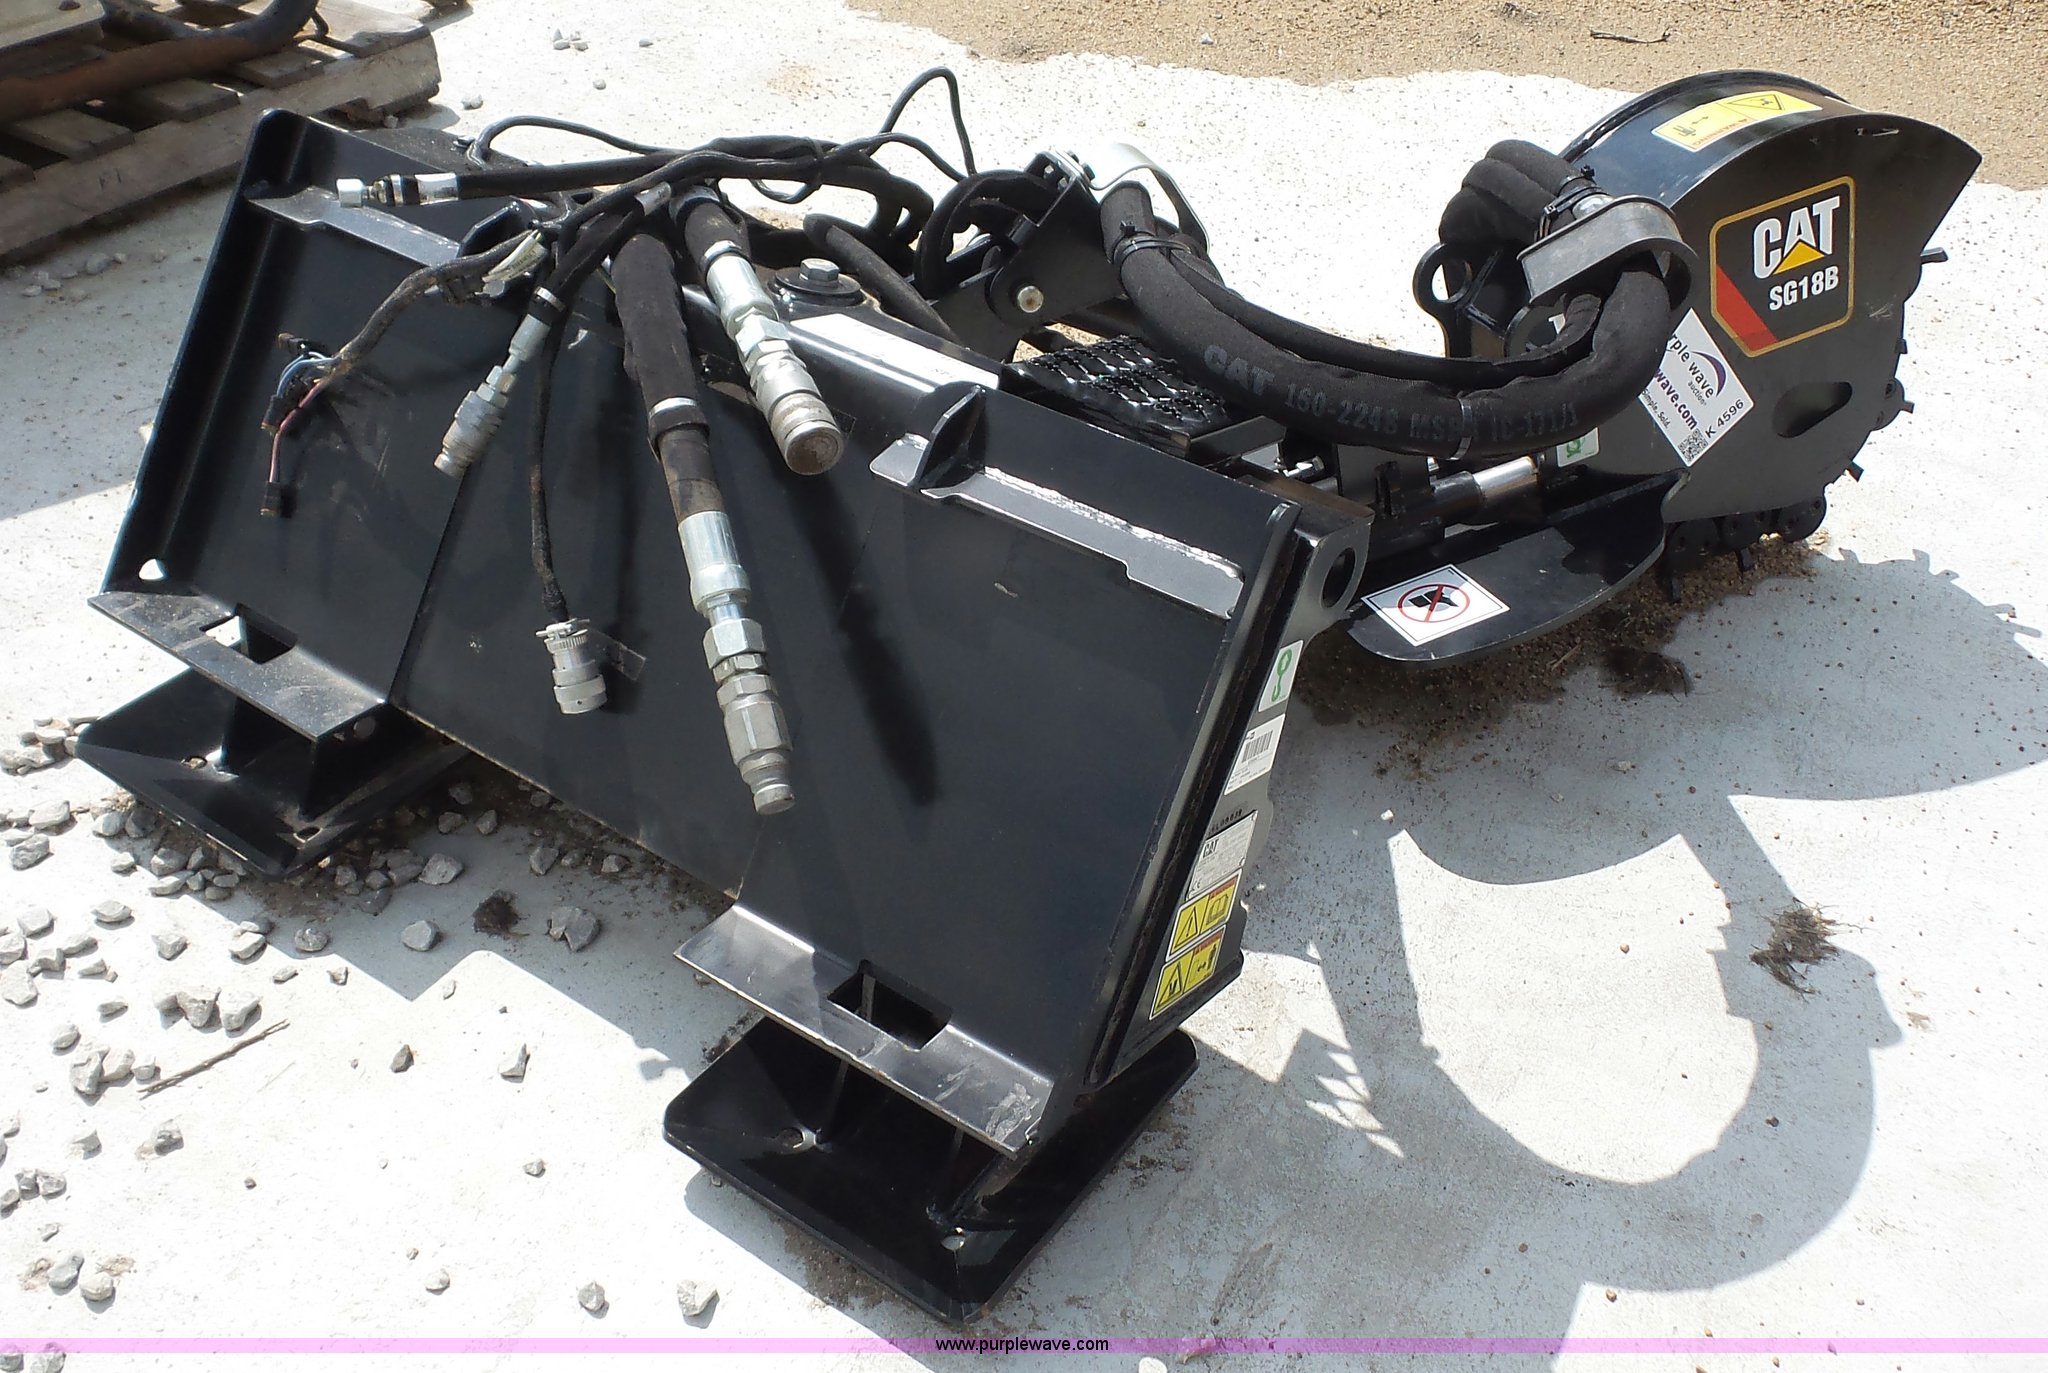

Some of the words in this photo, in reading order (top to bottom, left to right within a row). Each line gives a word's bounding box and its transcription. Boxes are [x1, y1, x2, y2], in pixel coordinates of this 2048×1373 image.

[1753, 196, 1840, 279] CAT
[1769, 266, 1839, 311] SG18B
[1204, 344, 1275, 396] CAT
[1688, 362, 1714, 398] wave
[1705, 426, 1716, 439] K
[1717, 399, 1744, 429] 4596
[1203, 839, 1219, 858] CAT
